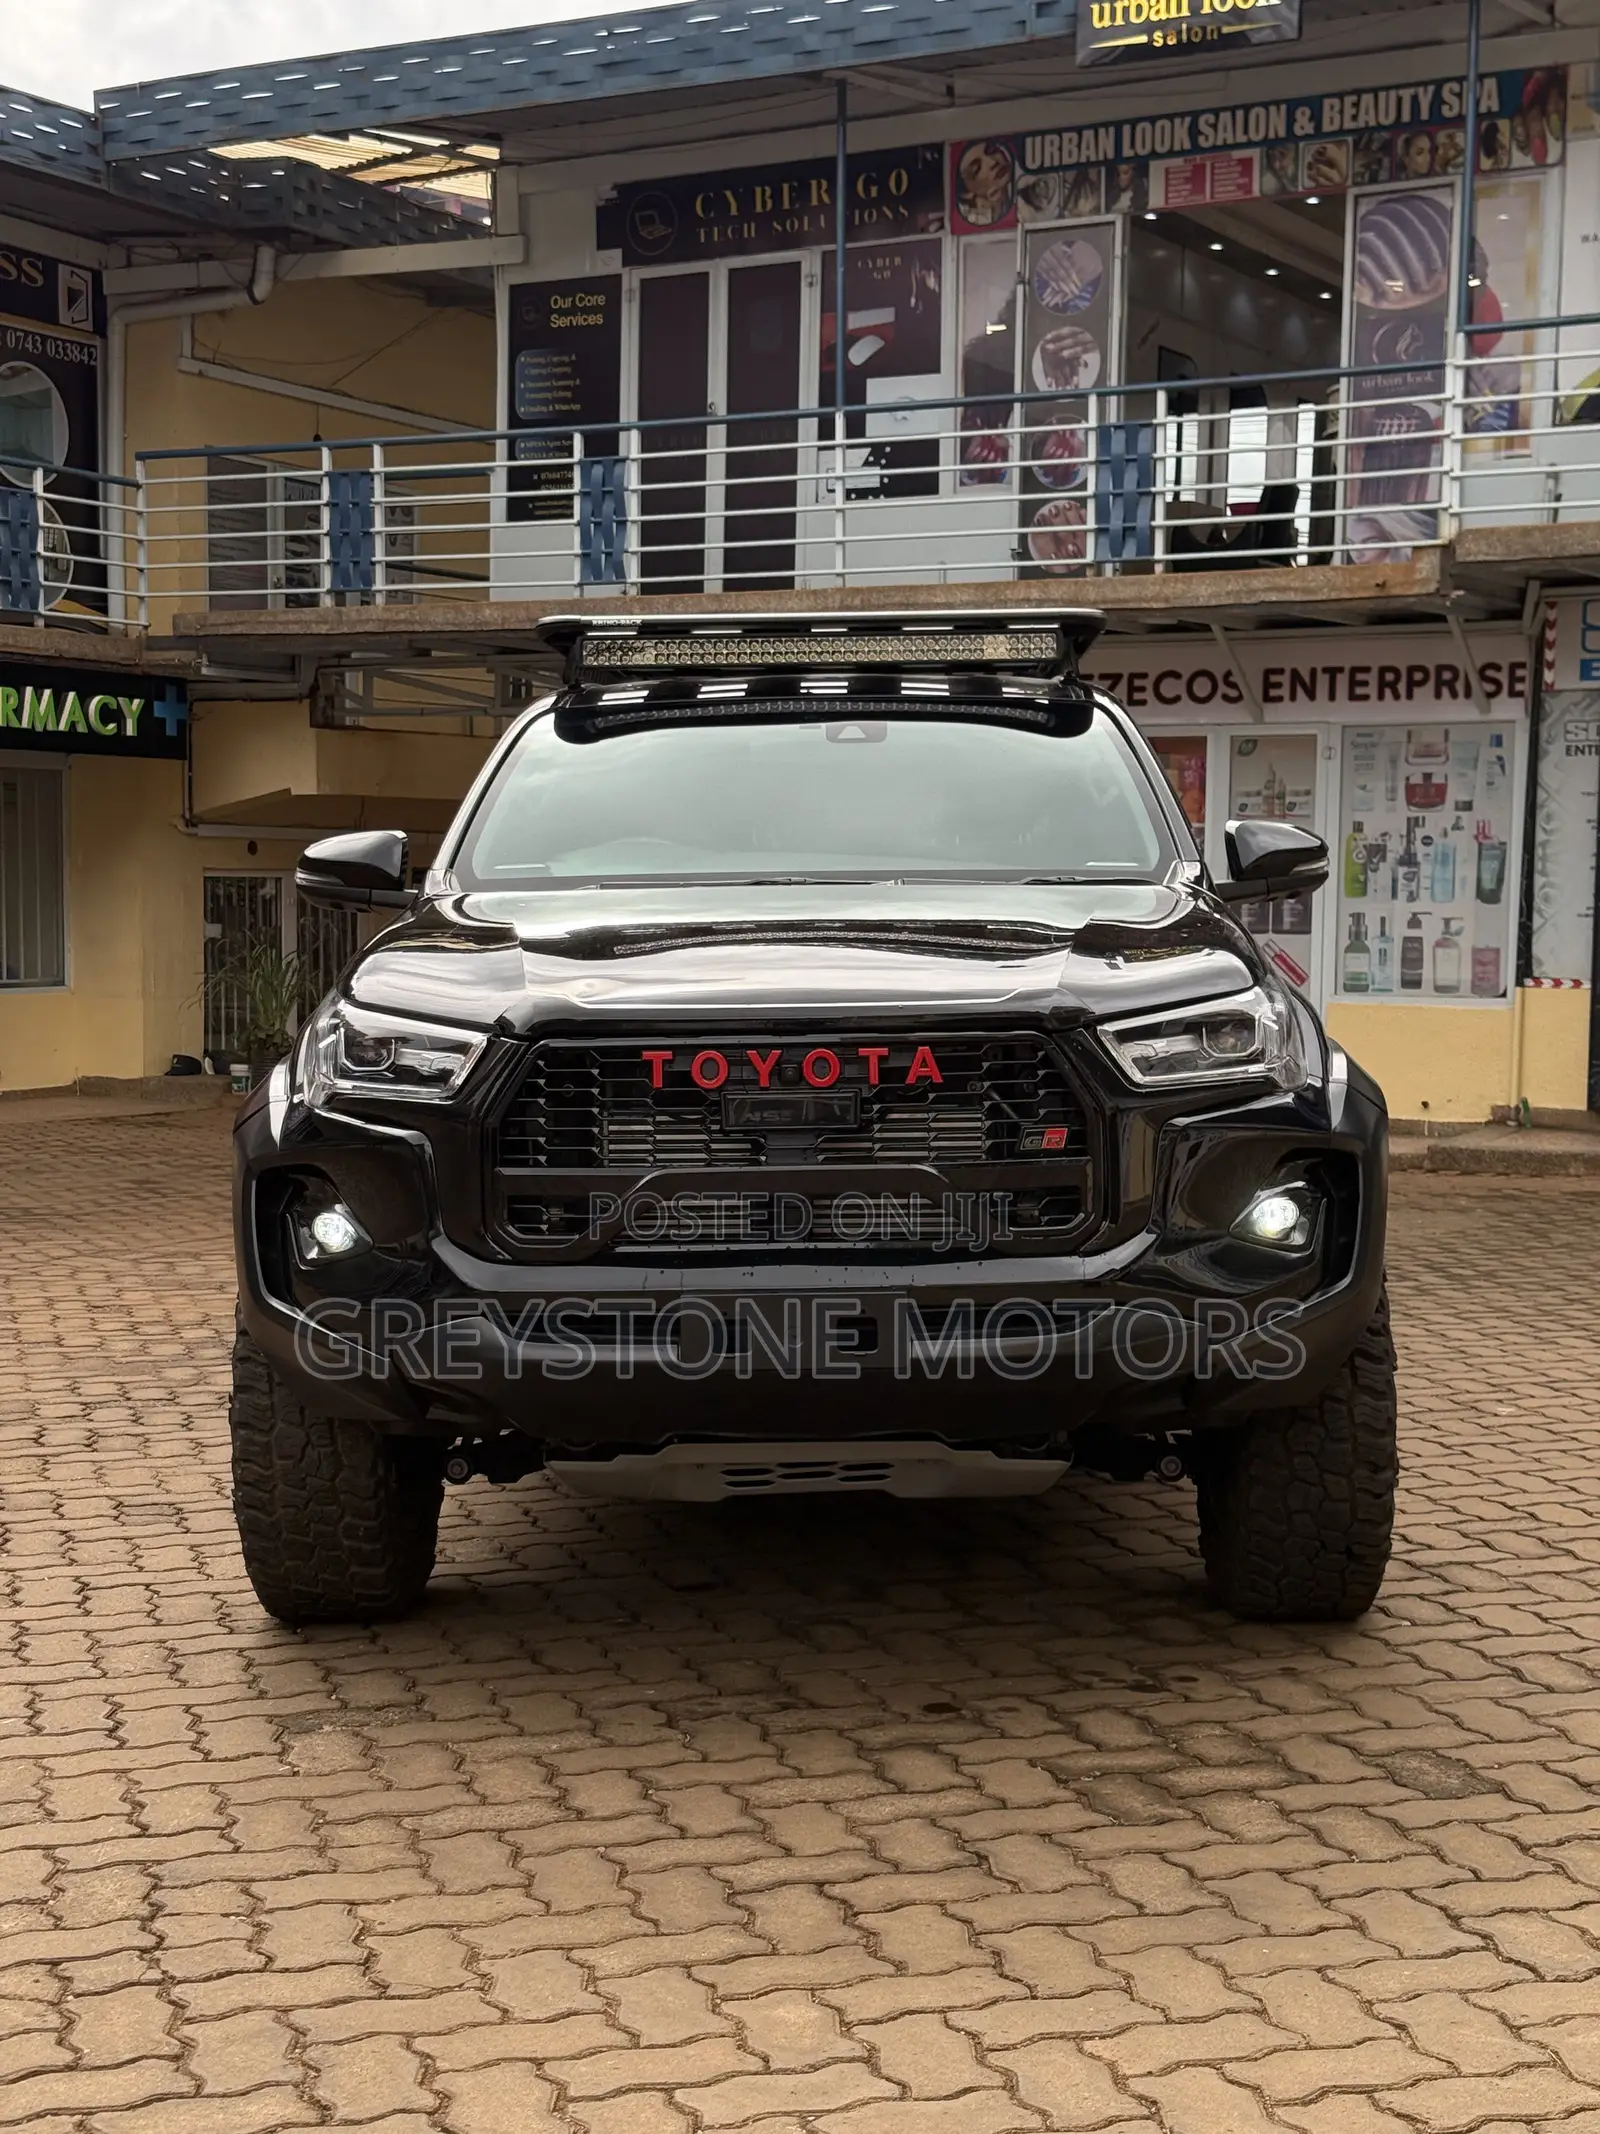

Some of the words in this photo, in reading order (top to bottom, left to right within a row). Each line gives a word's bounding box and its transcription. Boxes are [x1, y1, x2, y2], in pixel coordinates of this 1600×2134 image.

[1151, 22, 1219, 47] salon
[1024, 126, 1116, 171] URBAN
[1121, 115, 1193, 159] LOOK
[1197, 103, 1288, 149] SALON
[1293, 105, 1315, 137] &
[1321, 84, 1437, 133] BEAUTY
[695, 177, 832, 220] CYBER
[856, 167, 910, 201] GO
[696, 220, 756, 244] TECH
[550, 294, 574, 310] Our
[575, 292, 607, 308] Core
[550, 312, 604, 328] Services
[7, 329, 42, 355] 0743
[46, 338, 98, 367] 033842
[1079, 669, 1244, 707] ZECOS
[1262, 661, 1527, 704] ENTERPRISE
[0, 686, 145, 737] RMACY
[641, 1045, 944, 1090] TOYOTA
[1022, 1132, 1066, 1149] GR
